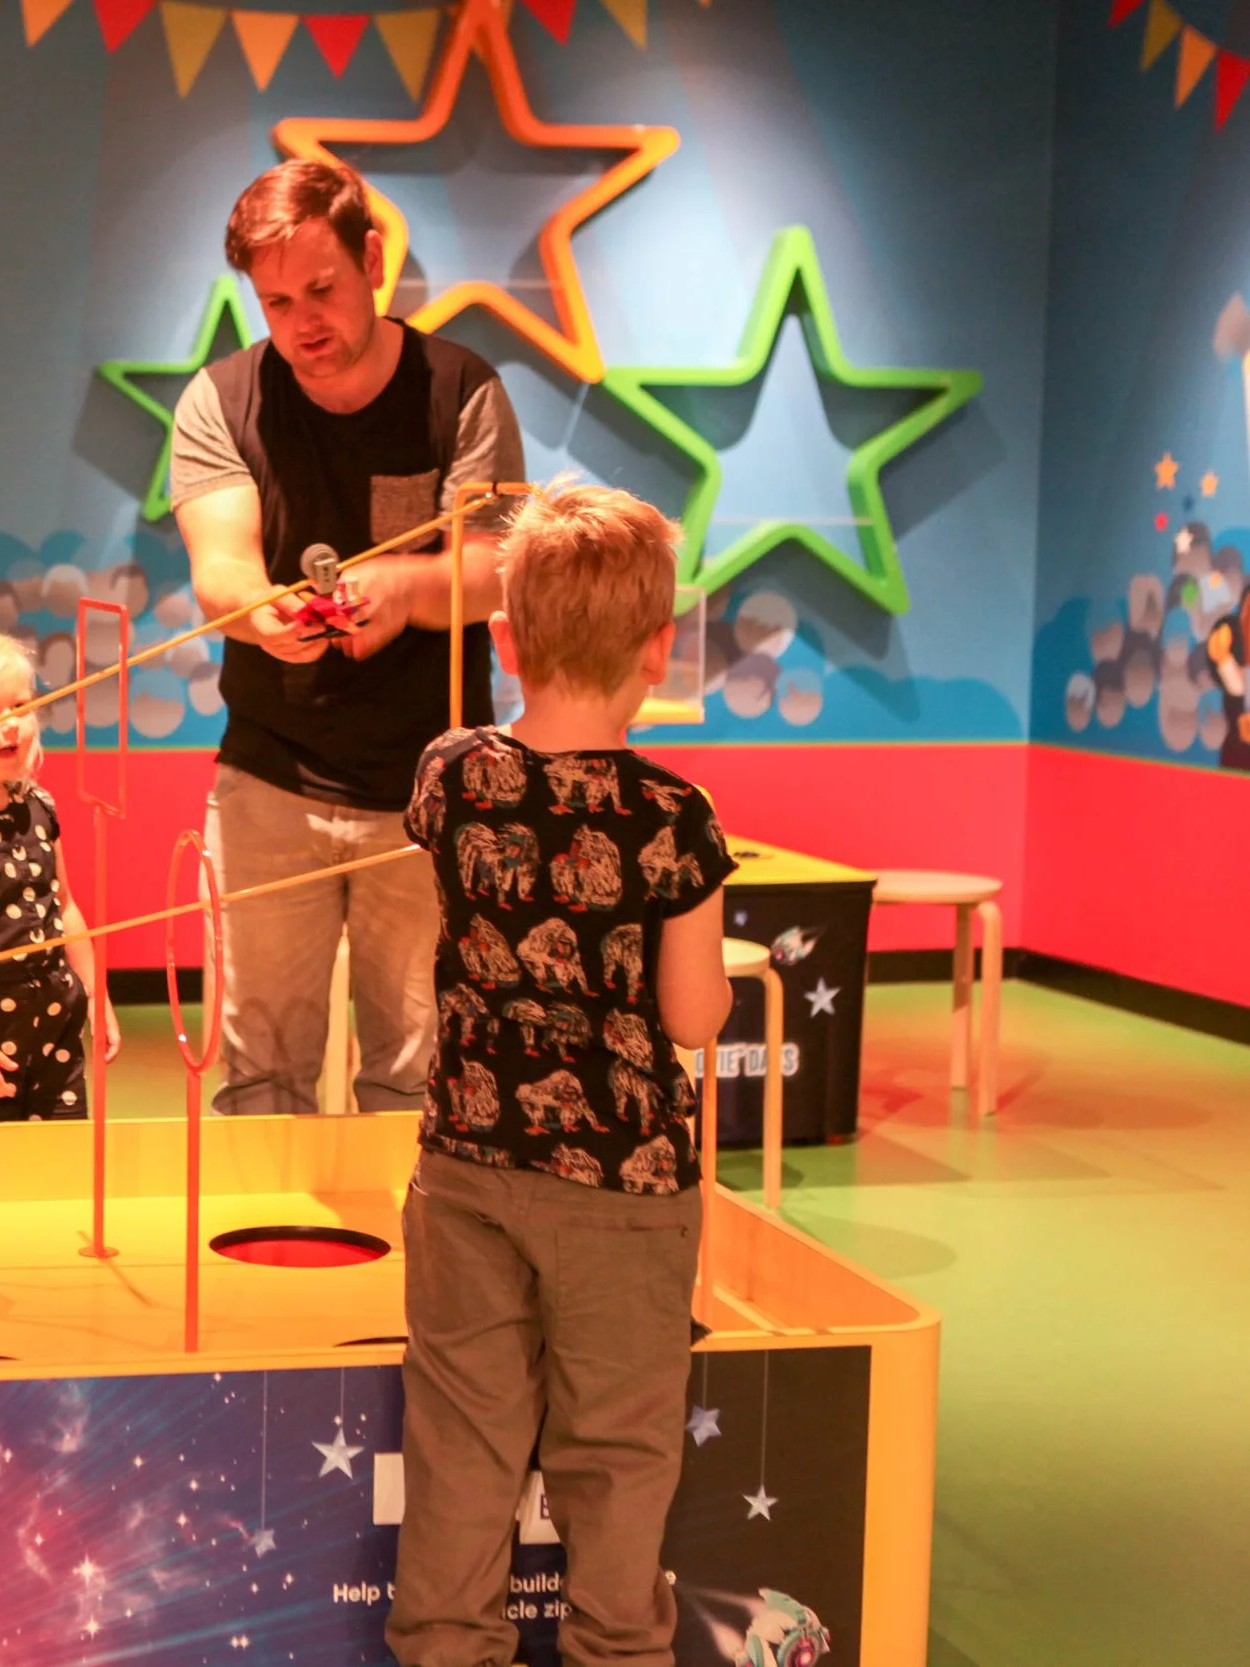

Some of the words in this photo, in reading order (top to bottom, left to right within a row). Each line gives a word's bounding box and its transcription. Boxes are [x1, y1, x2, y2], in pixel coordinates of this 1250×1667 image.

[749, 1047, 798, 1073] DAS
[333, 1580, 381, 1607] Help
[510, 1571, 563, 1593] build
